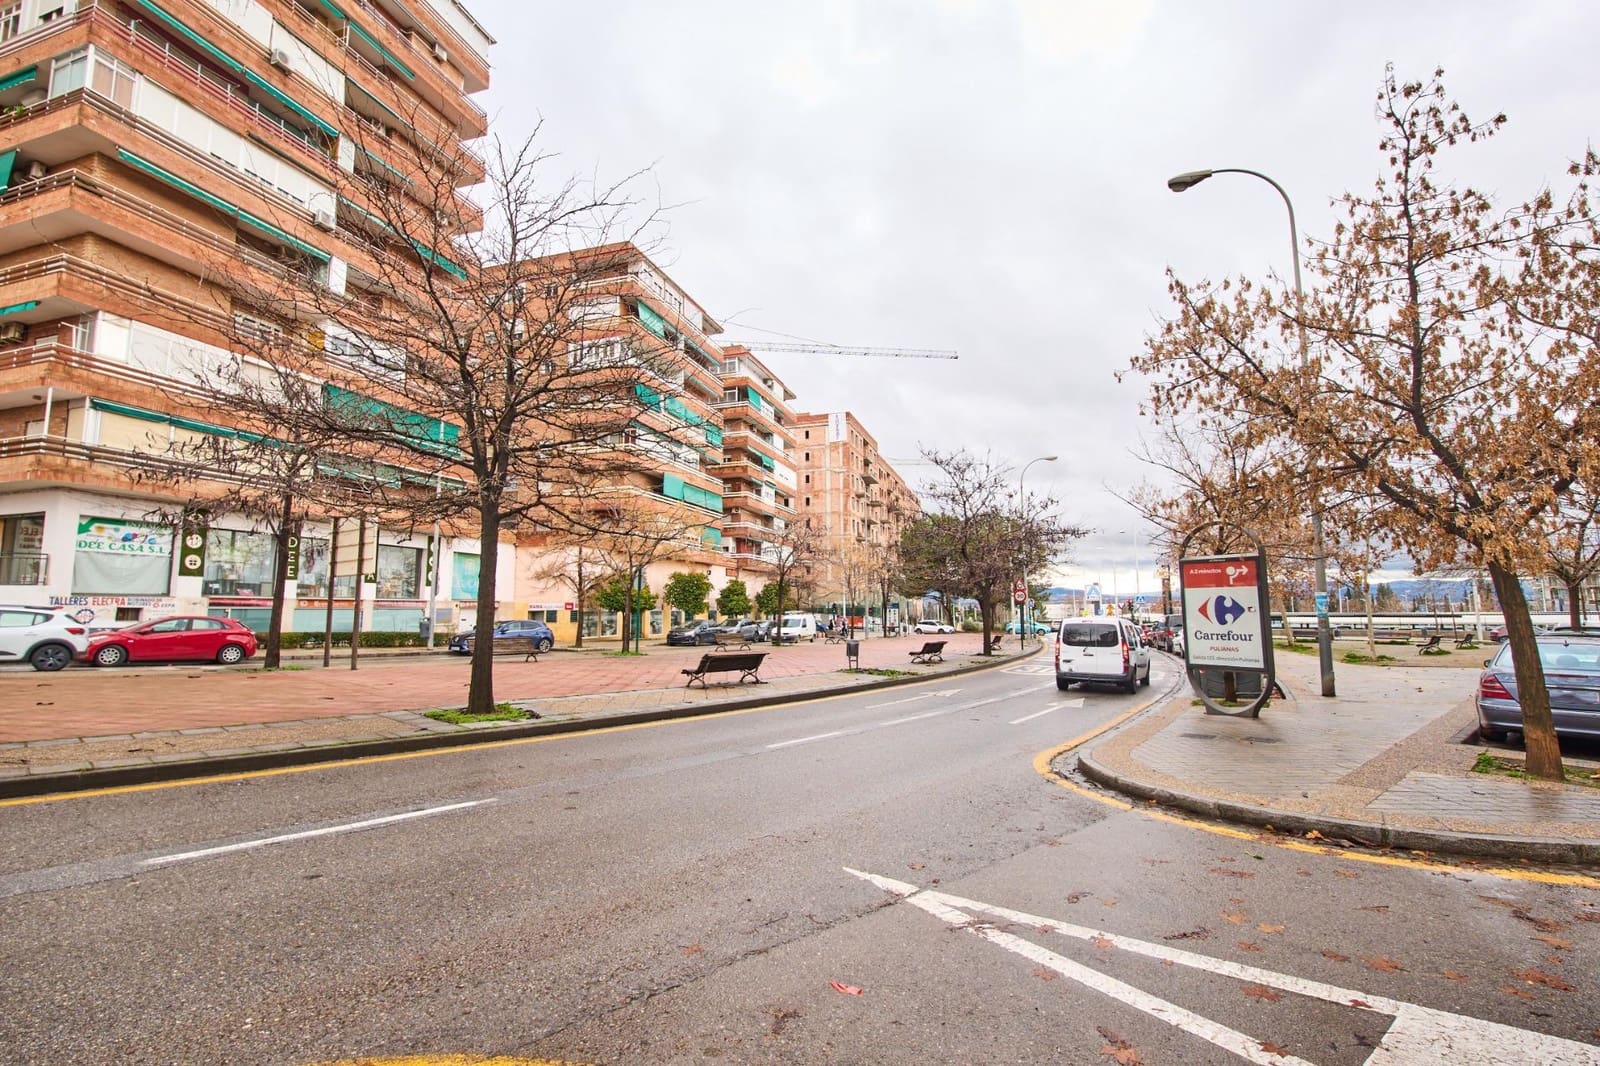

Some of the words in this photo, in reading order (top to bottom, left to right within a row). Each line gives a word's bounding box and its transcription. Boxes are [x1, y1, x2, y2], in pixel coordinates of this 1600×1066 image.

[108, 543, 144, 553] CASA
[50, 596, 89, 606] TALLERES
[1194, 630, 1254, 642] Carrefour
